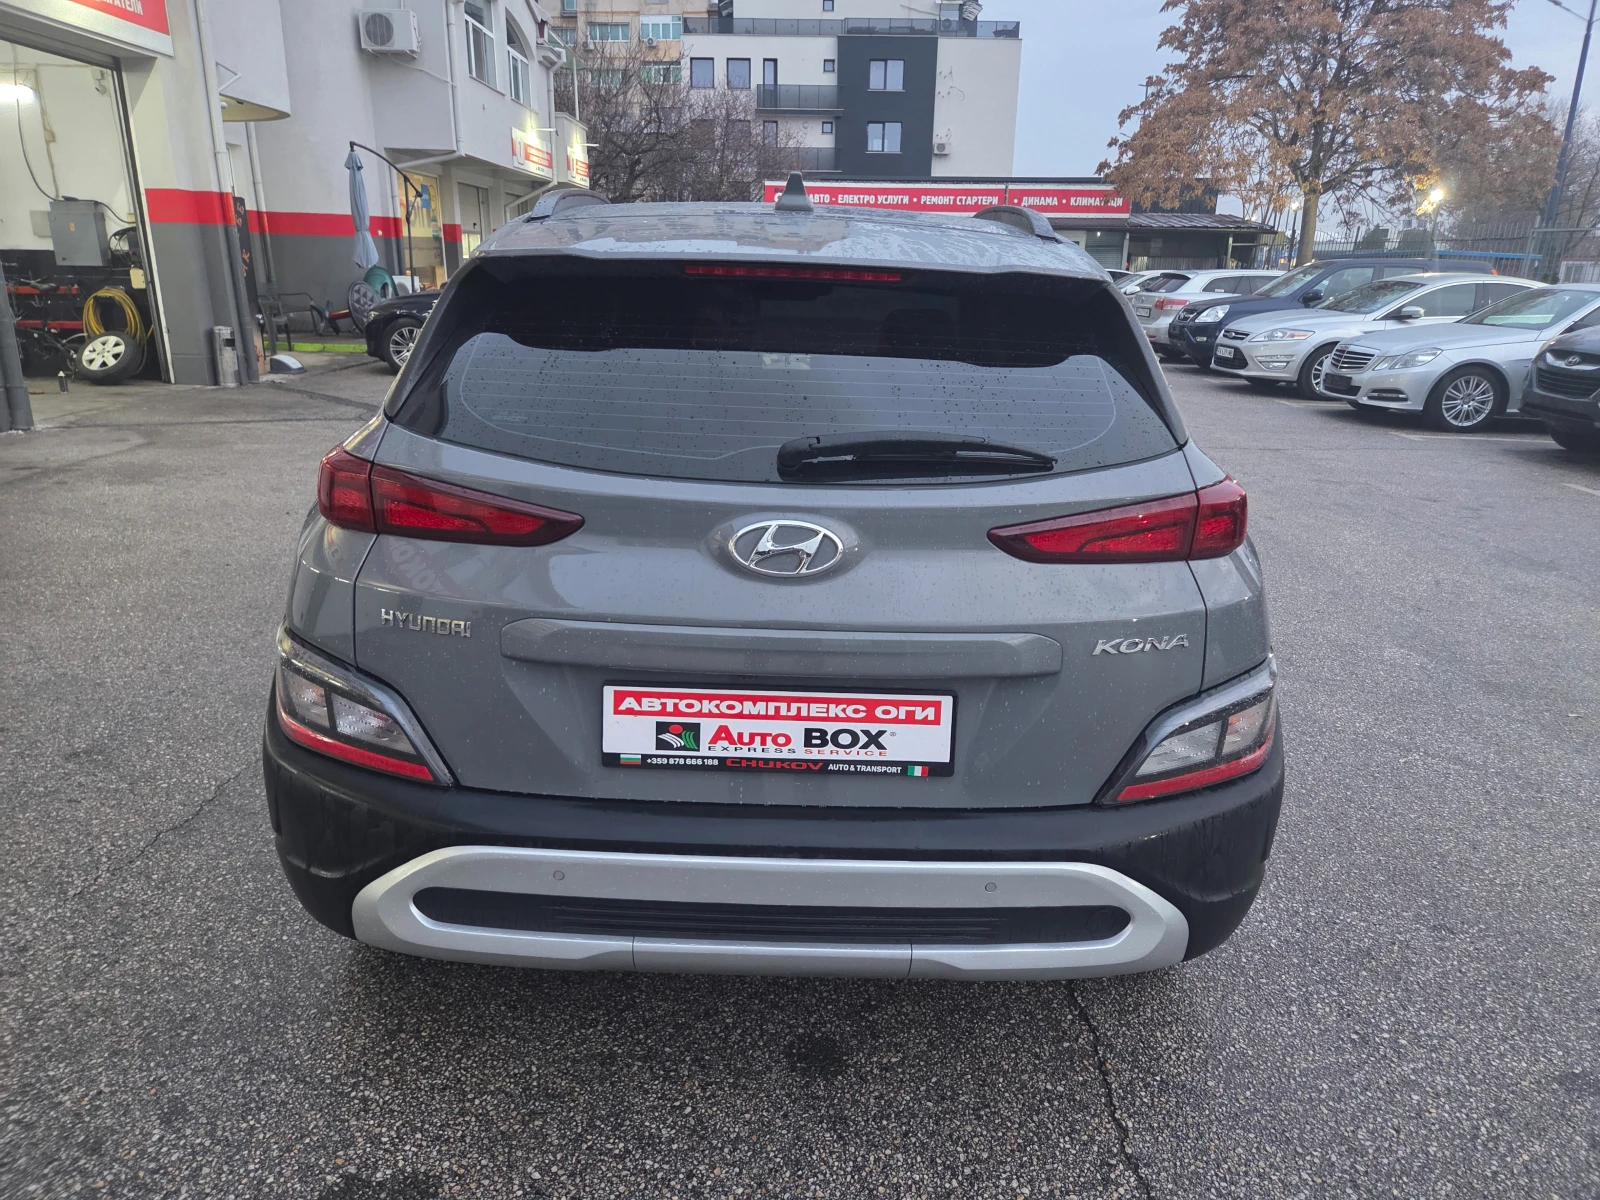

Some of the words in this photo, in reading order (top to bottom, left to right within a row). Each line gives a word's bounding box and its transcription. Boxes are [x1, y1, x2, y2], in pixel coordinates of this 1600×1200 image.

[809, 193, 830, 203] АВТО
[838, 194, 875, 204] ЕЛЕКТРО
[877, 195, 909, 205] УСЛУГИ
[920, 195, 955, 205] РЕМОНТ
[956, 196, 999, 206] СТАРТЕРИ
[1021, 196, 1058, 207] ДИНАМА
[1070, 196, 1123, 207] КЛИМАЦИ
[381, 608, 471, 638] HYUNDAI
[1092, 633, 1190, 656] KONA
[618, 698, 867, 718] АВТОКОМПЛЕКС
[874, 705, 935, 720] ОГИ
[708, 746, 796, 754] EXPRESS
[804, 749, 888, 757] SERVICE
[726, 758, 823, 770] CHUKOV
[828, 763, 848, 771] AUTO
[857, 765, 902, 774] TRANSPORT
